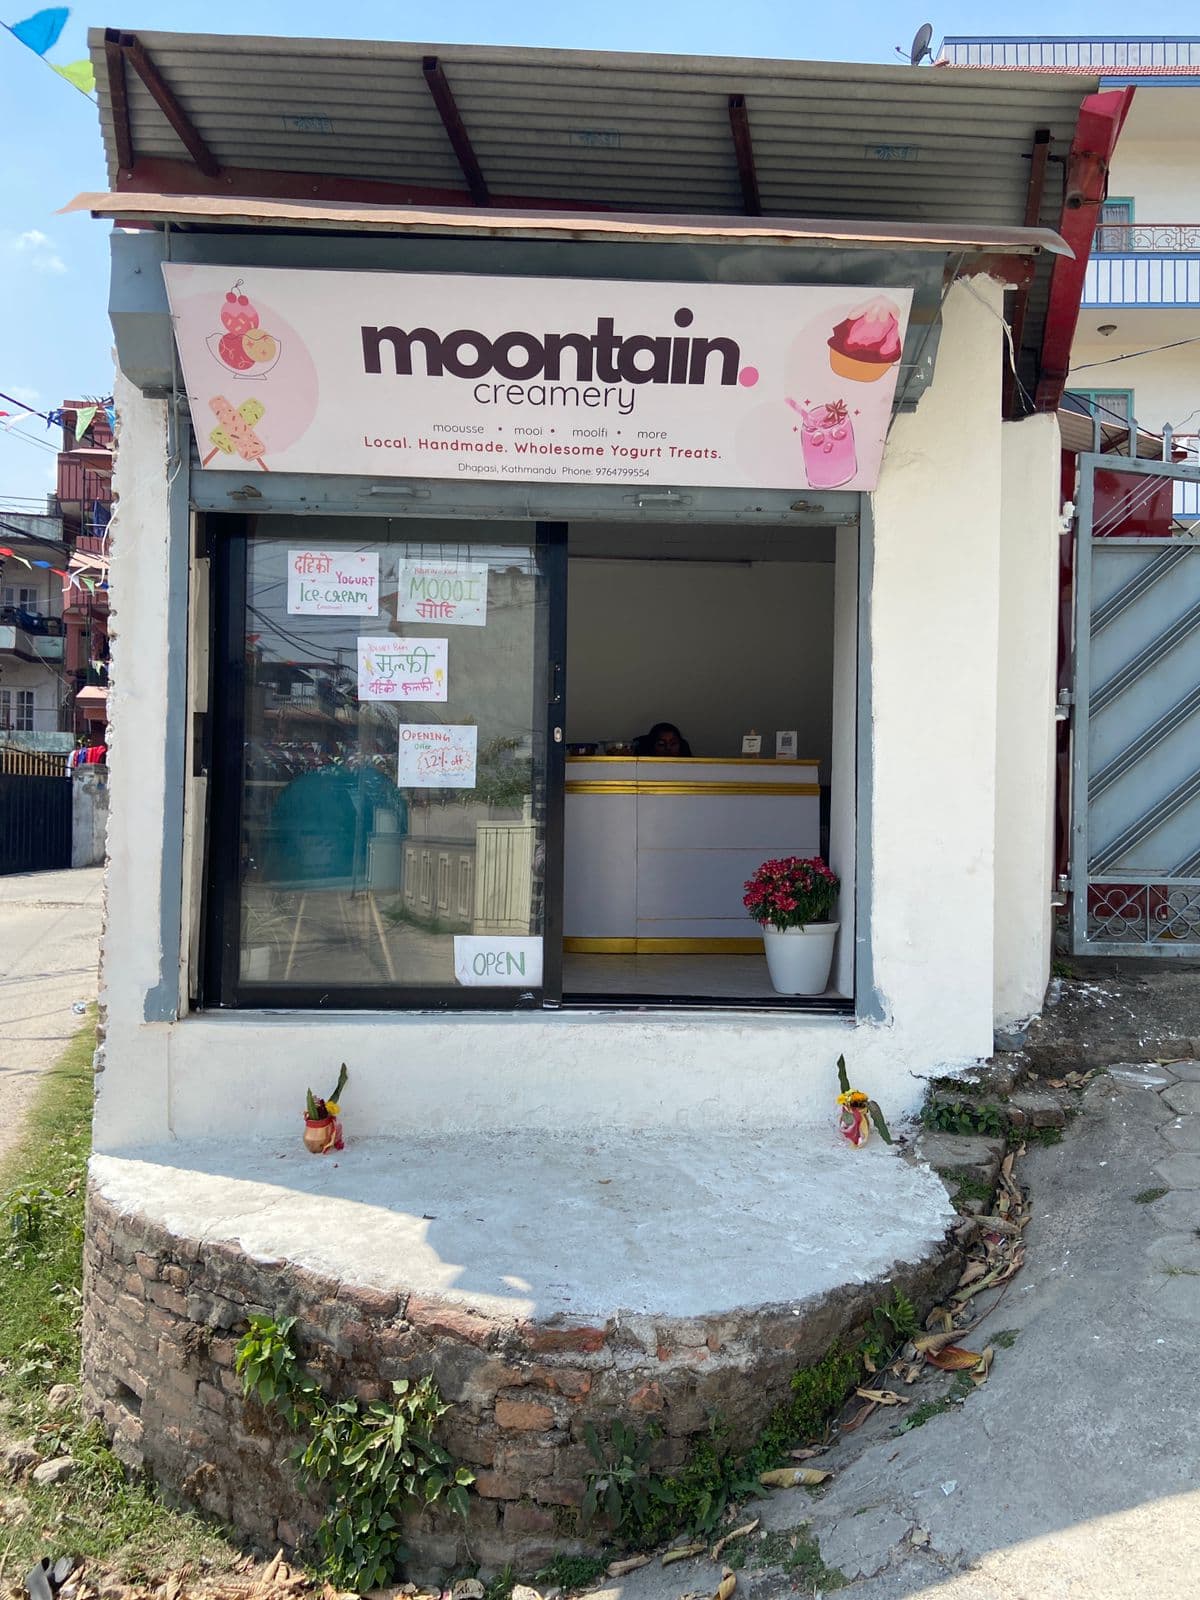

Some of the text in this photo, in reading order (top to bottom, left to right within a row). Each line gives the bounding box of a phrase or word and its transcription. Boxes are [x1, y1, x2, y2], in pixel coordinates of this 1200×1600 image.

[474, 383, 635, 415] creamery
[433, 423, 668, 439] moousse mooi moolfi more
[364, 436, 722, 459] Local. Handmade. Wholesome Yogurt Treats.
[458, 463, 499, 474] Dhapasi,
[501, 464, 557, 475] Kathmandu
[595, 467, 650, 477] 9764799554
[402, 729, 451, 742] OPENING
[424, 752, 464, 768] 12% off
[472, 951, 526, 977] OPEN
